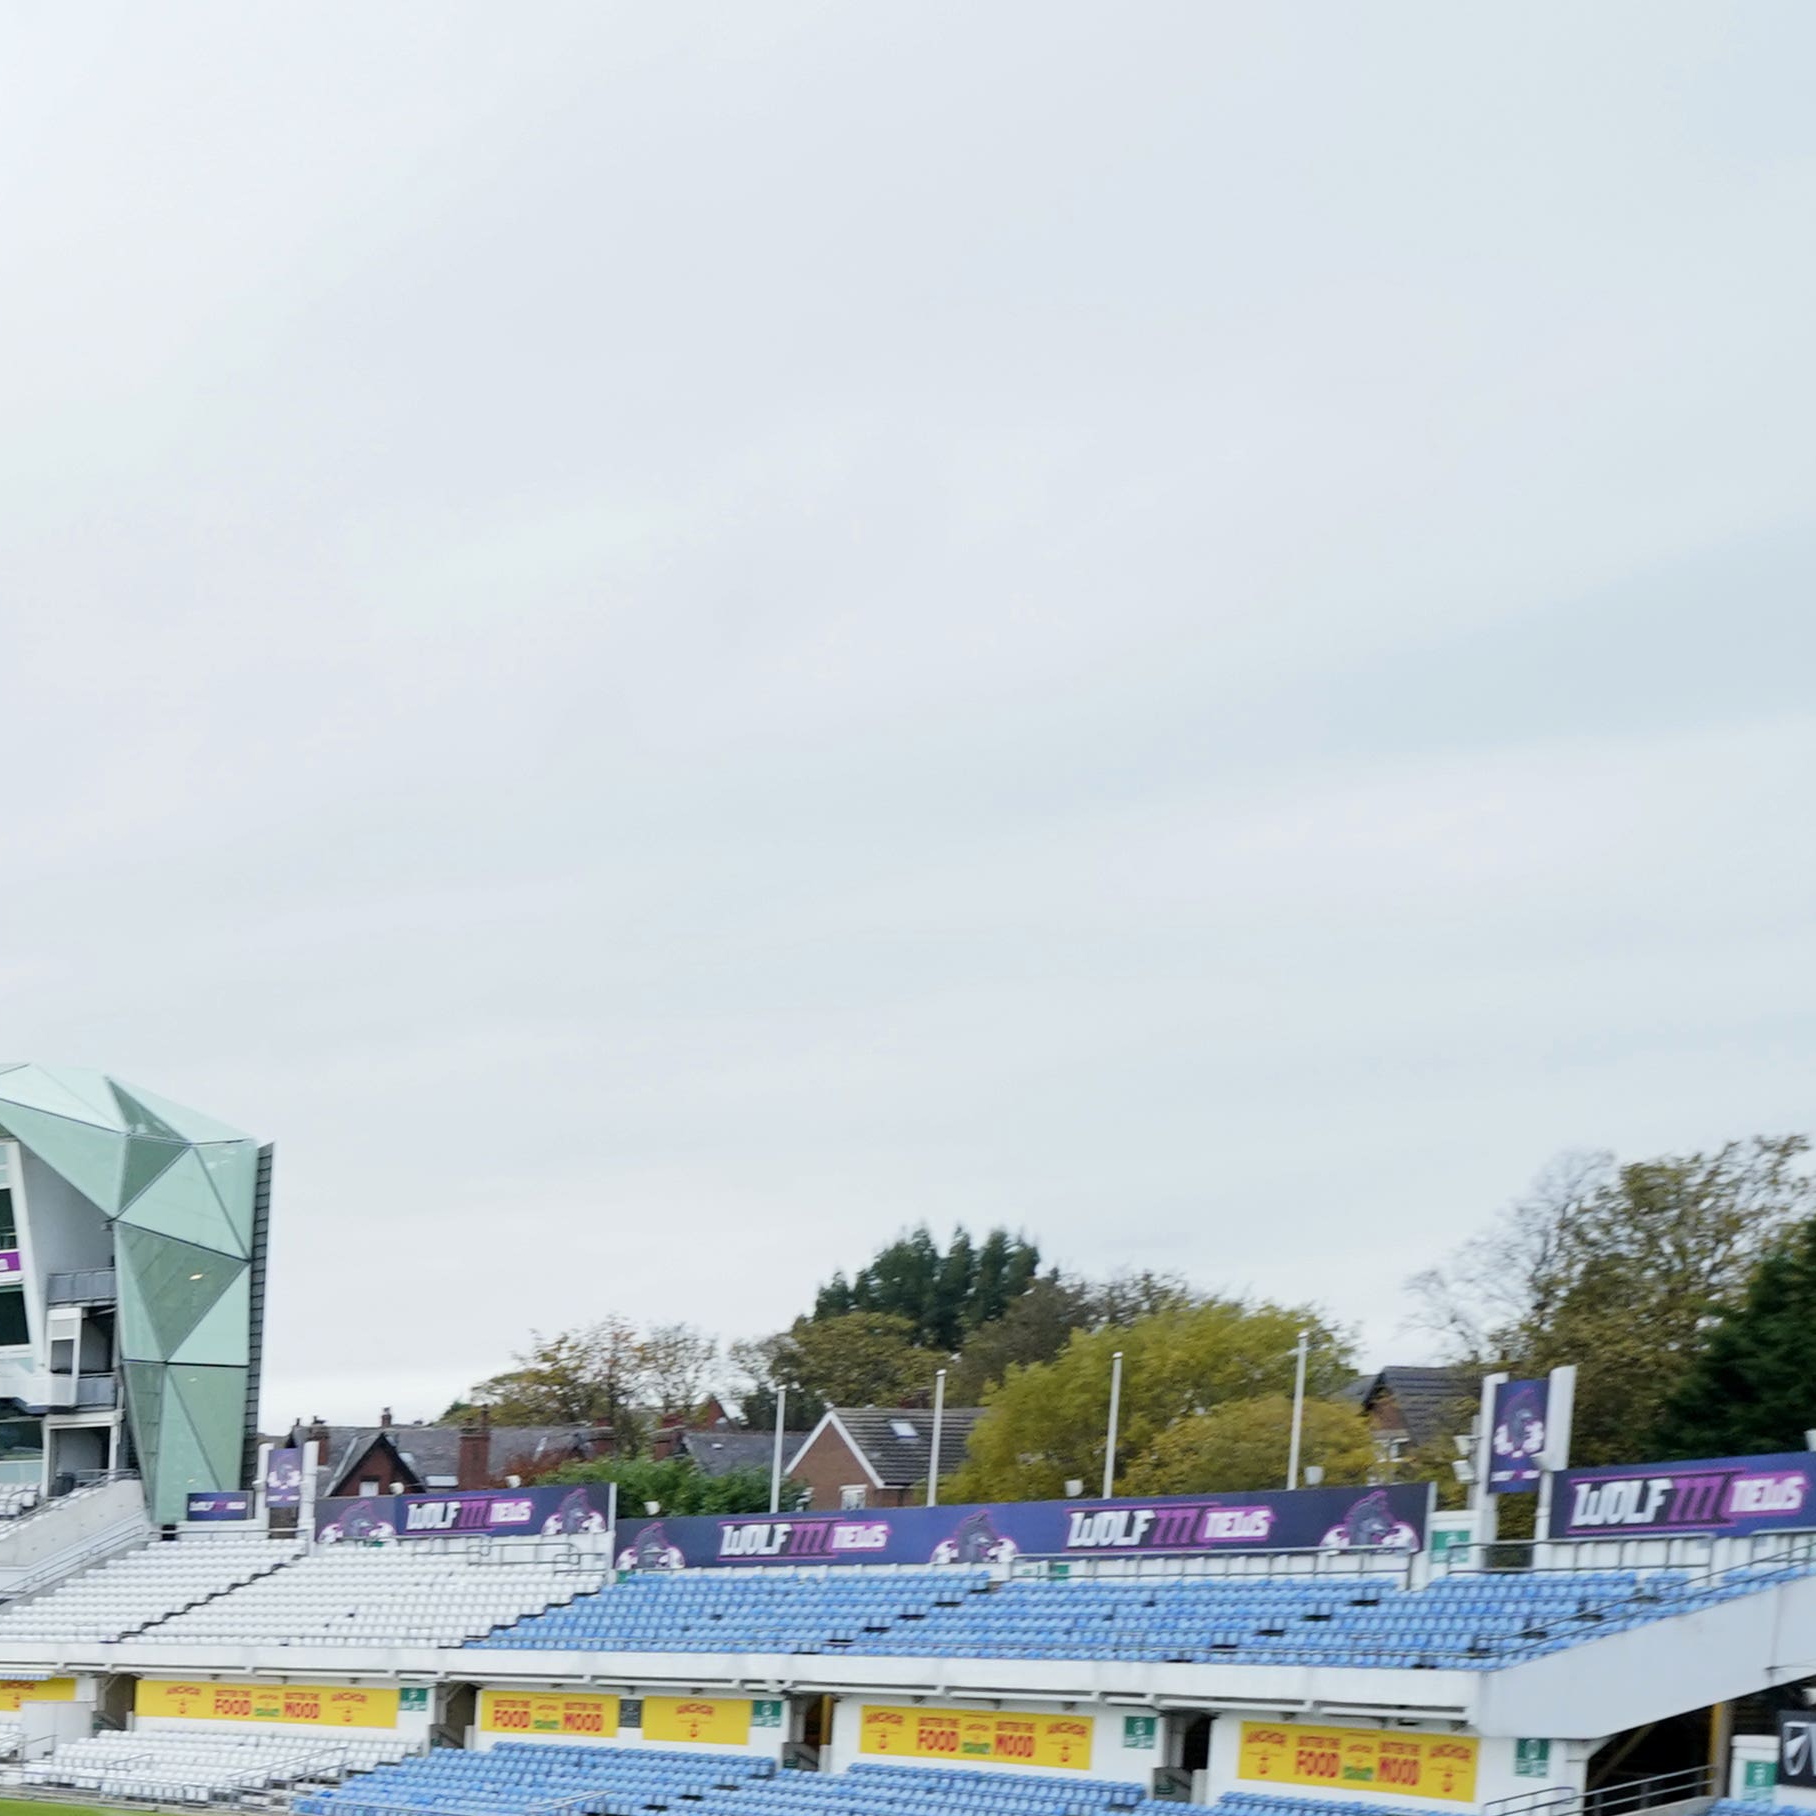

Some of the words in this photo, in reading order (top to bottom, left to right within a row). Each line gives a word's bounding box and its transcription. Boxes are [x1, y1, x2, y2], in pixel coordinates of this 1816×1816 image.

[1728, 1475, 1806, 1512] NEWS
[490, 1499, 532, 1524] NEWS
[1203, 1507, 1270, 1538] NEWS
[831, 1521, 888, 1550] NEWS
[213, 1698, 251, 1716] FOOD
[284, 1702, 320, 1719] MOOD
[492, 1709, 531, 1729] FOOD
[563, 1712, 604, 1733] MOOD
[916, 1729, 960, 1752] FOOD
[994, 1733, 1035, 1758] MOOD
[1295, 1750, 1340, 1778] FOOD
[1377, 1756, 1419, 1786] MOOD
